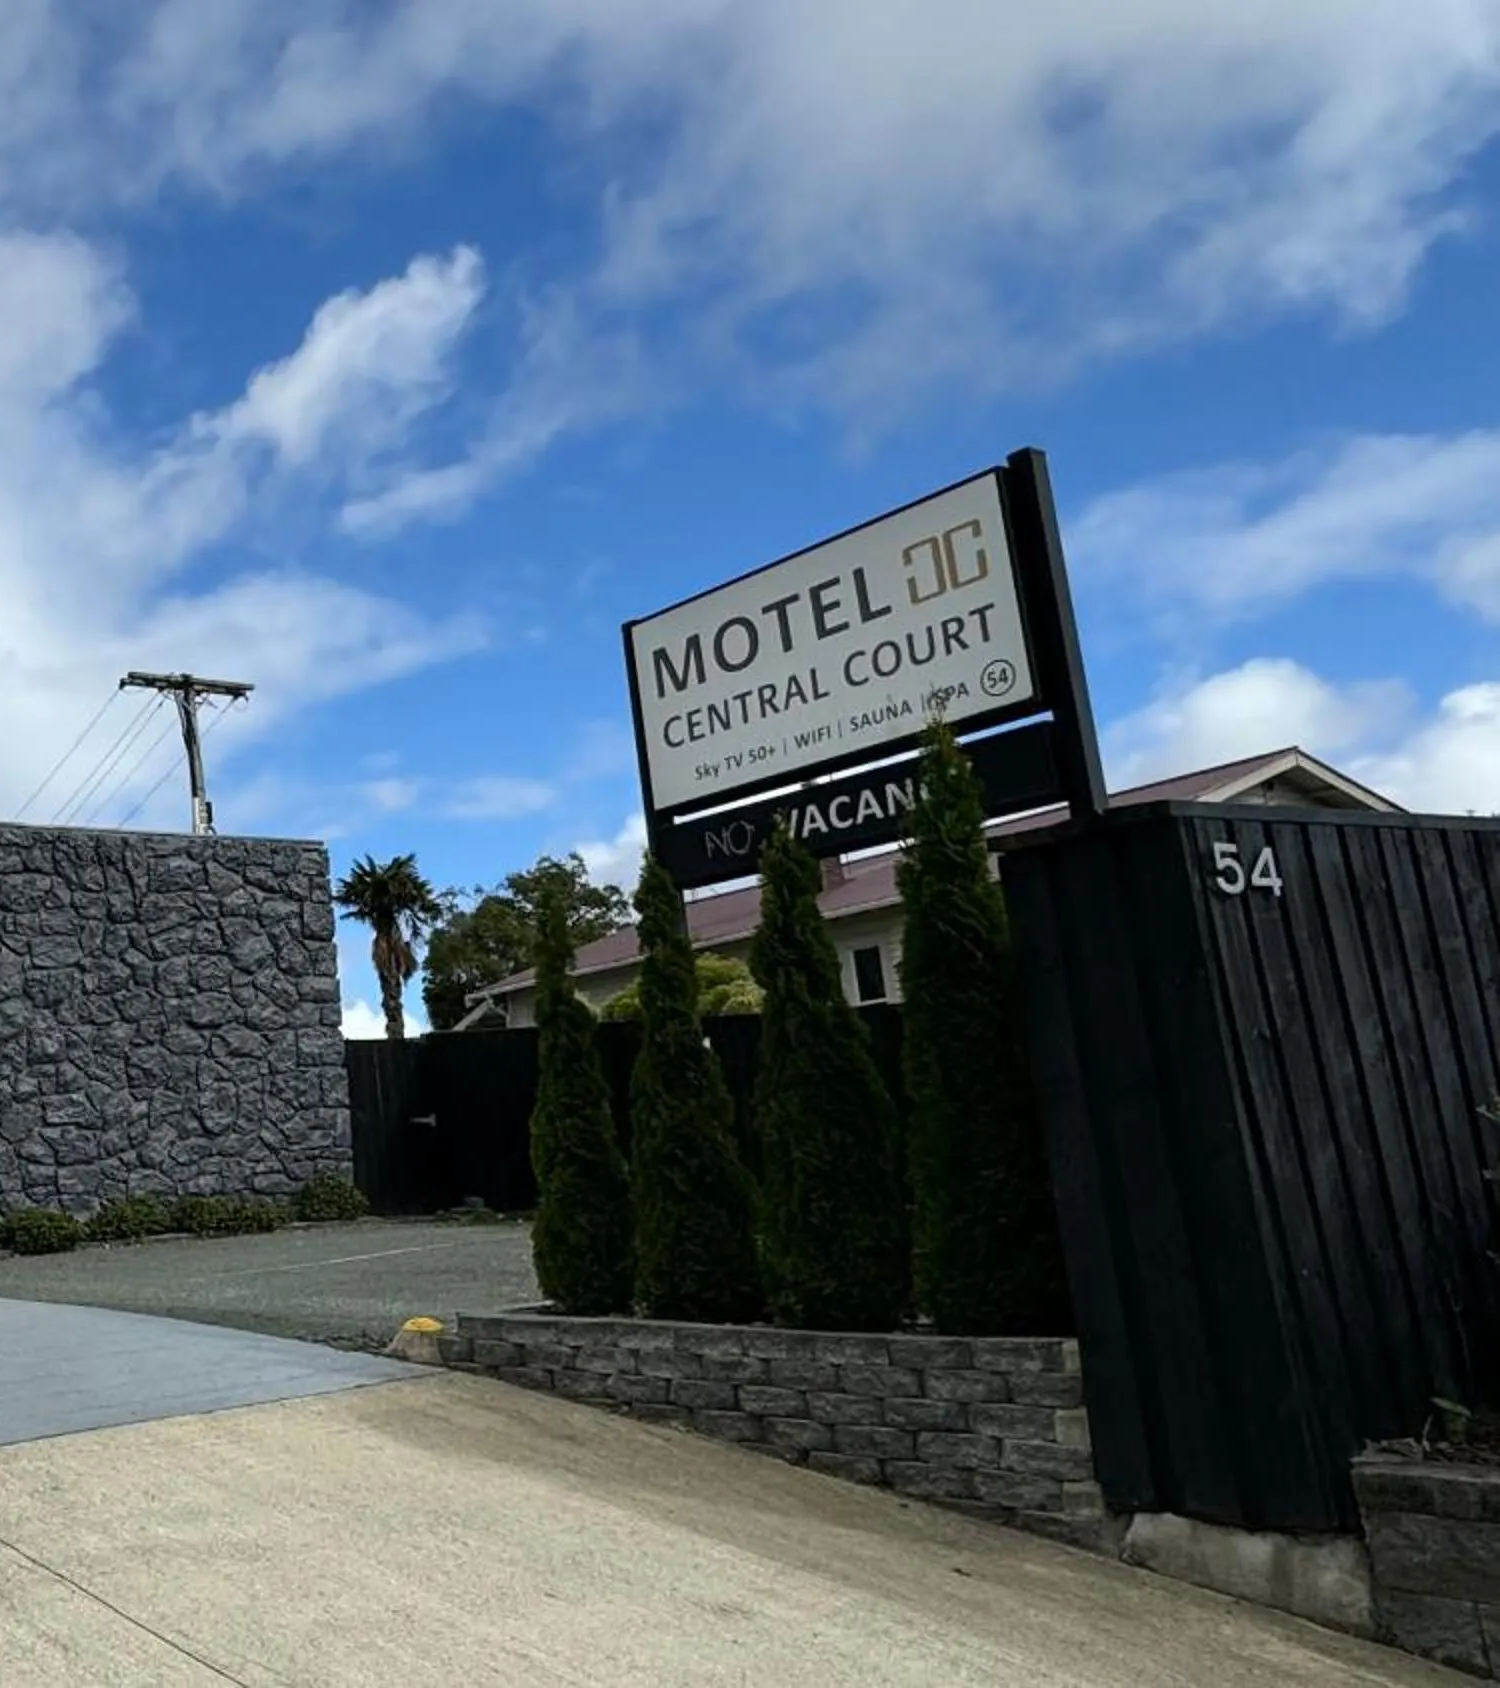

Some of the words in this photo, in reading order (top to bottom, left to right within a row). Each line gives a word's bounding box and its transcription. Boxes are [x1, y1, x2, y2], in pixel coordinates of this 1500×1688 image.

[652, 566, 892, 698] MOTEL
[662, 668, 830, 748] CENTRAL
[843, 603, 996, 688] COURT
[987, 666, 1008, 689] 54
[695, 763, 721, 781] Sky
[724, 753, 745, 771] TV
[748, 745, 777, 765] 50+
[794, 728, 833, 750] WIFI
[850, 702, 913, 733] SAUNA
[704, 819, 755, 859] NO
[779, 777, 931, 840] VACAN
[1213, 842, 1283, 897] 54
